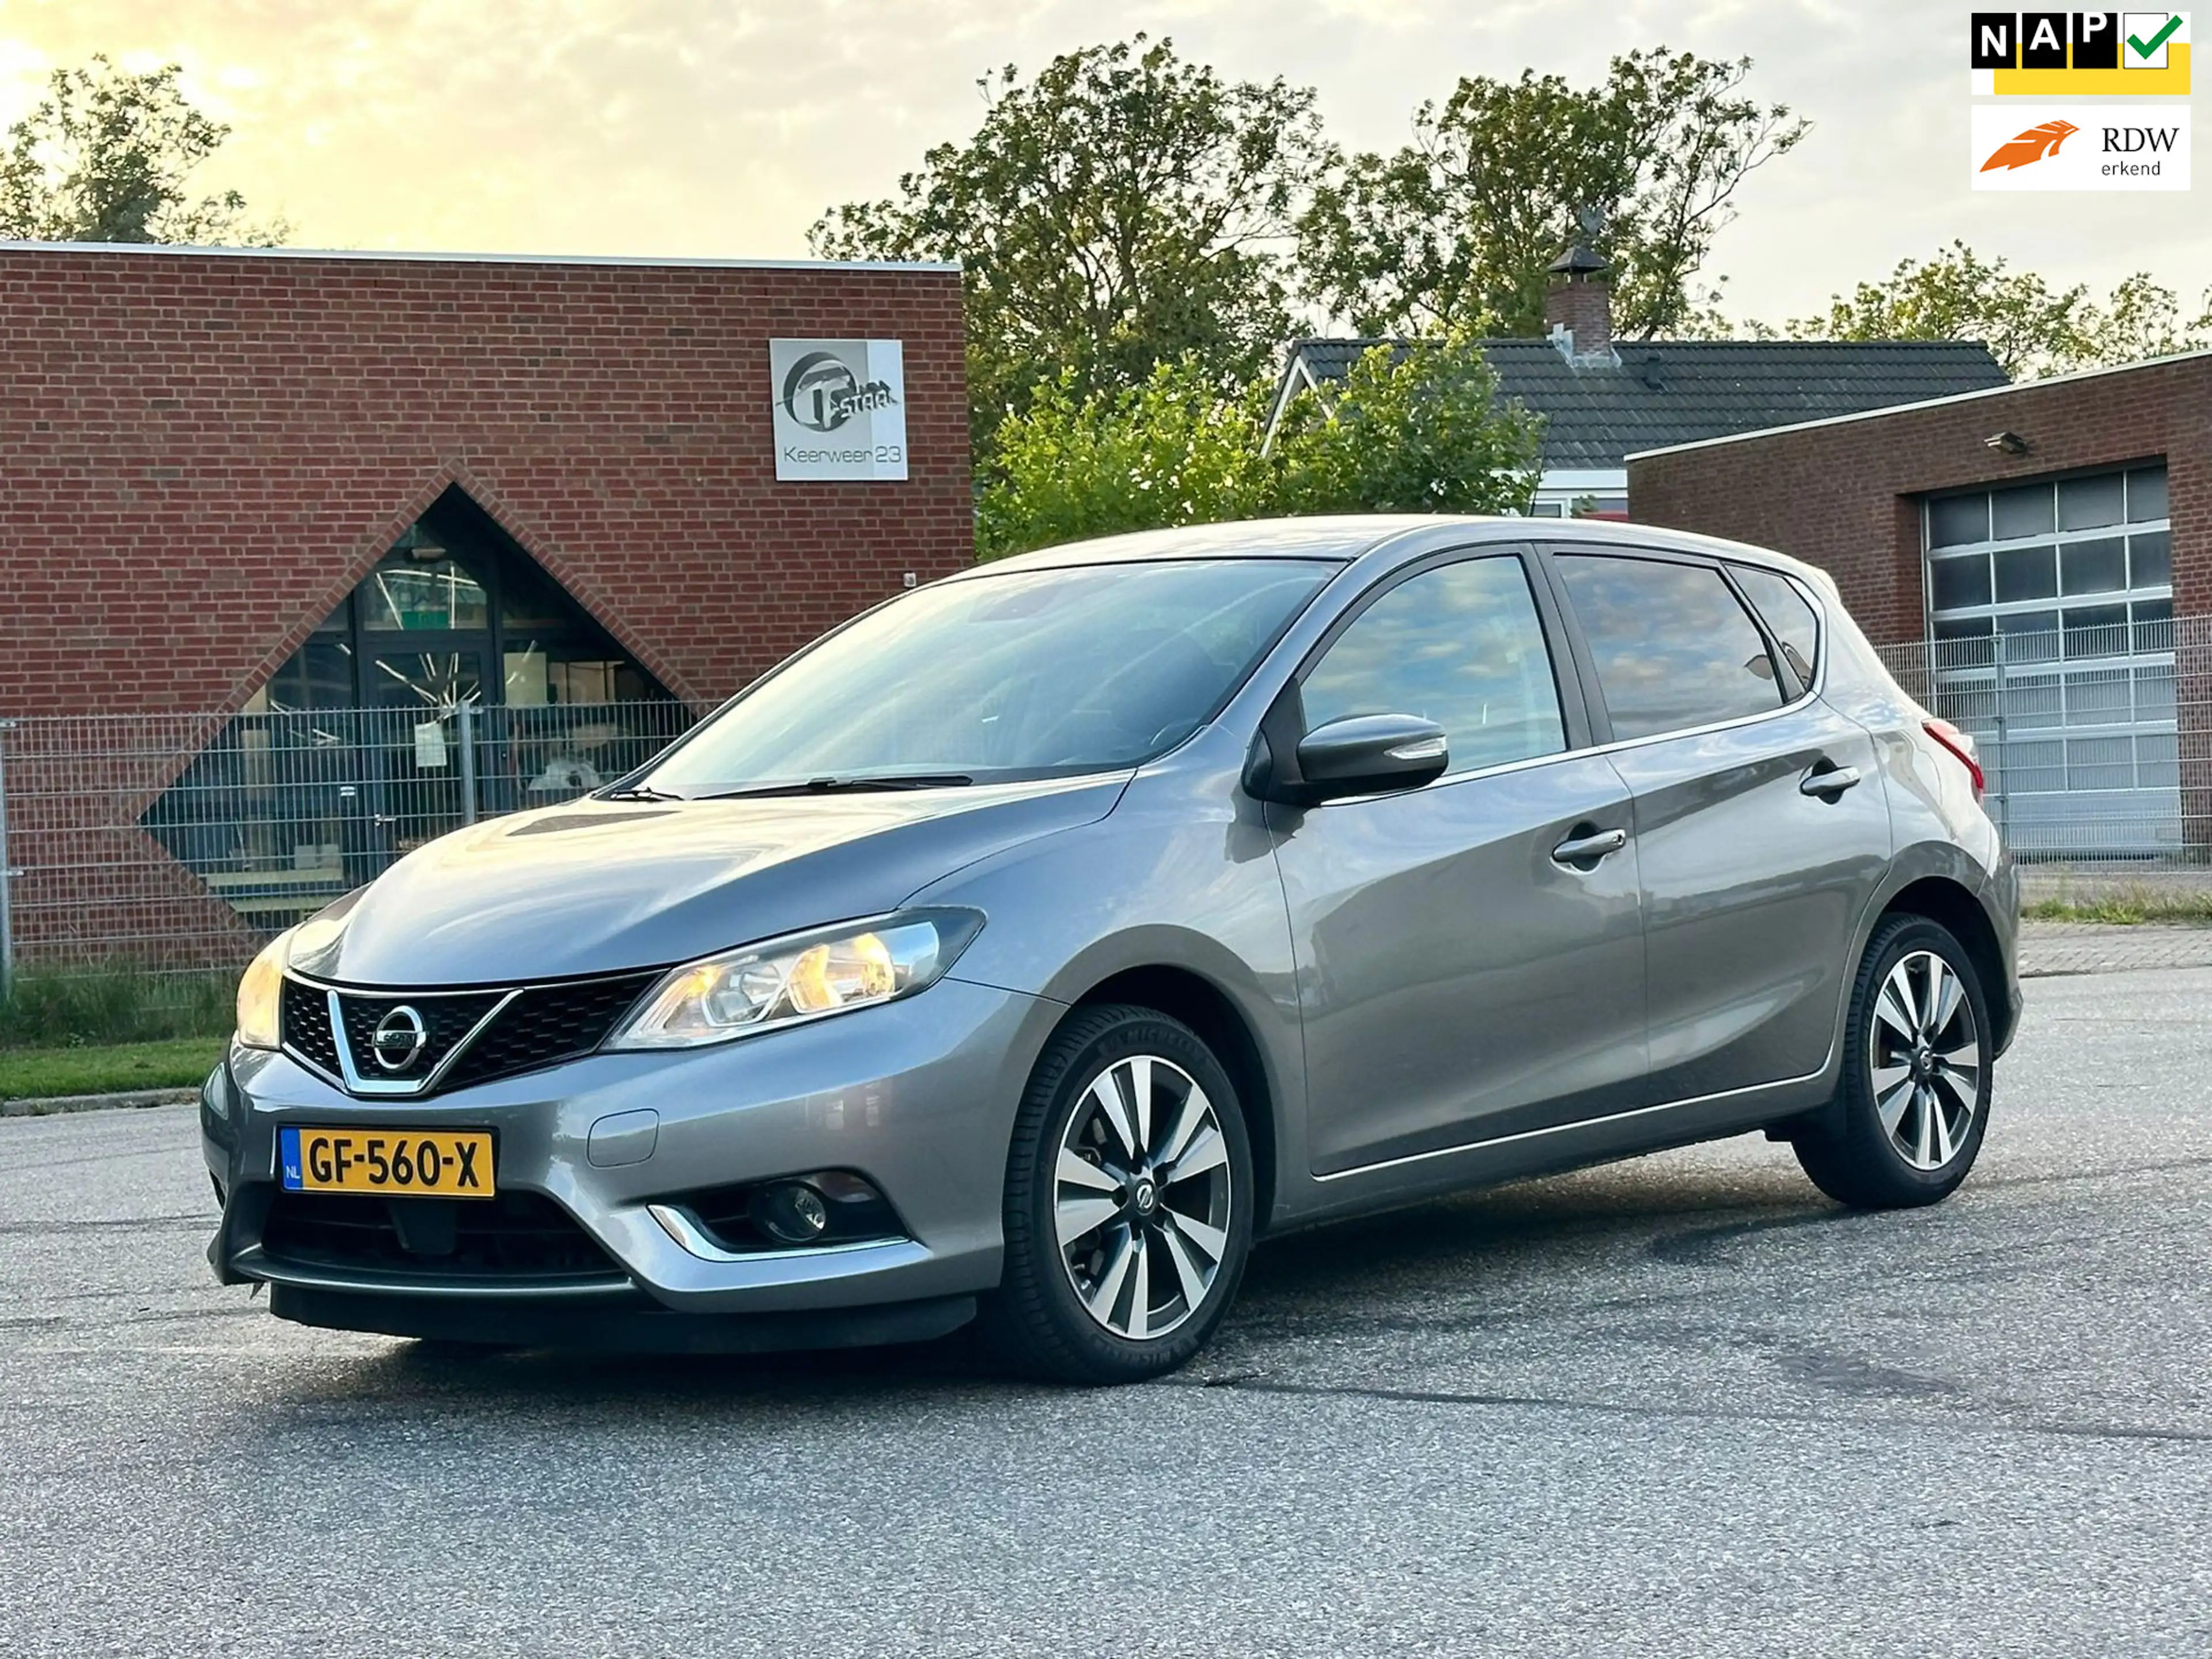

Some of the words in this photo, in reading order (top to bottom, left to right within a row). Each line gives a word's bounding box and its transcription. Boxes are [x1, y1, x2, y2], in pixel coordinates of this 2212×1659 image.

[783, 446, 873, 463] Keerweer
[875, 446, 902, 463] 23
[286, 1165, 300, 1179] NL
[309, 1138, 480, 1188] GF-560-X
